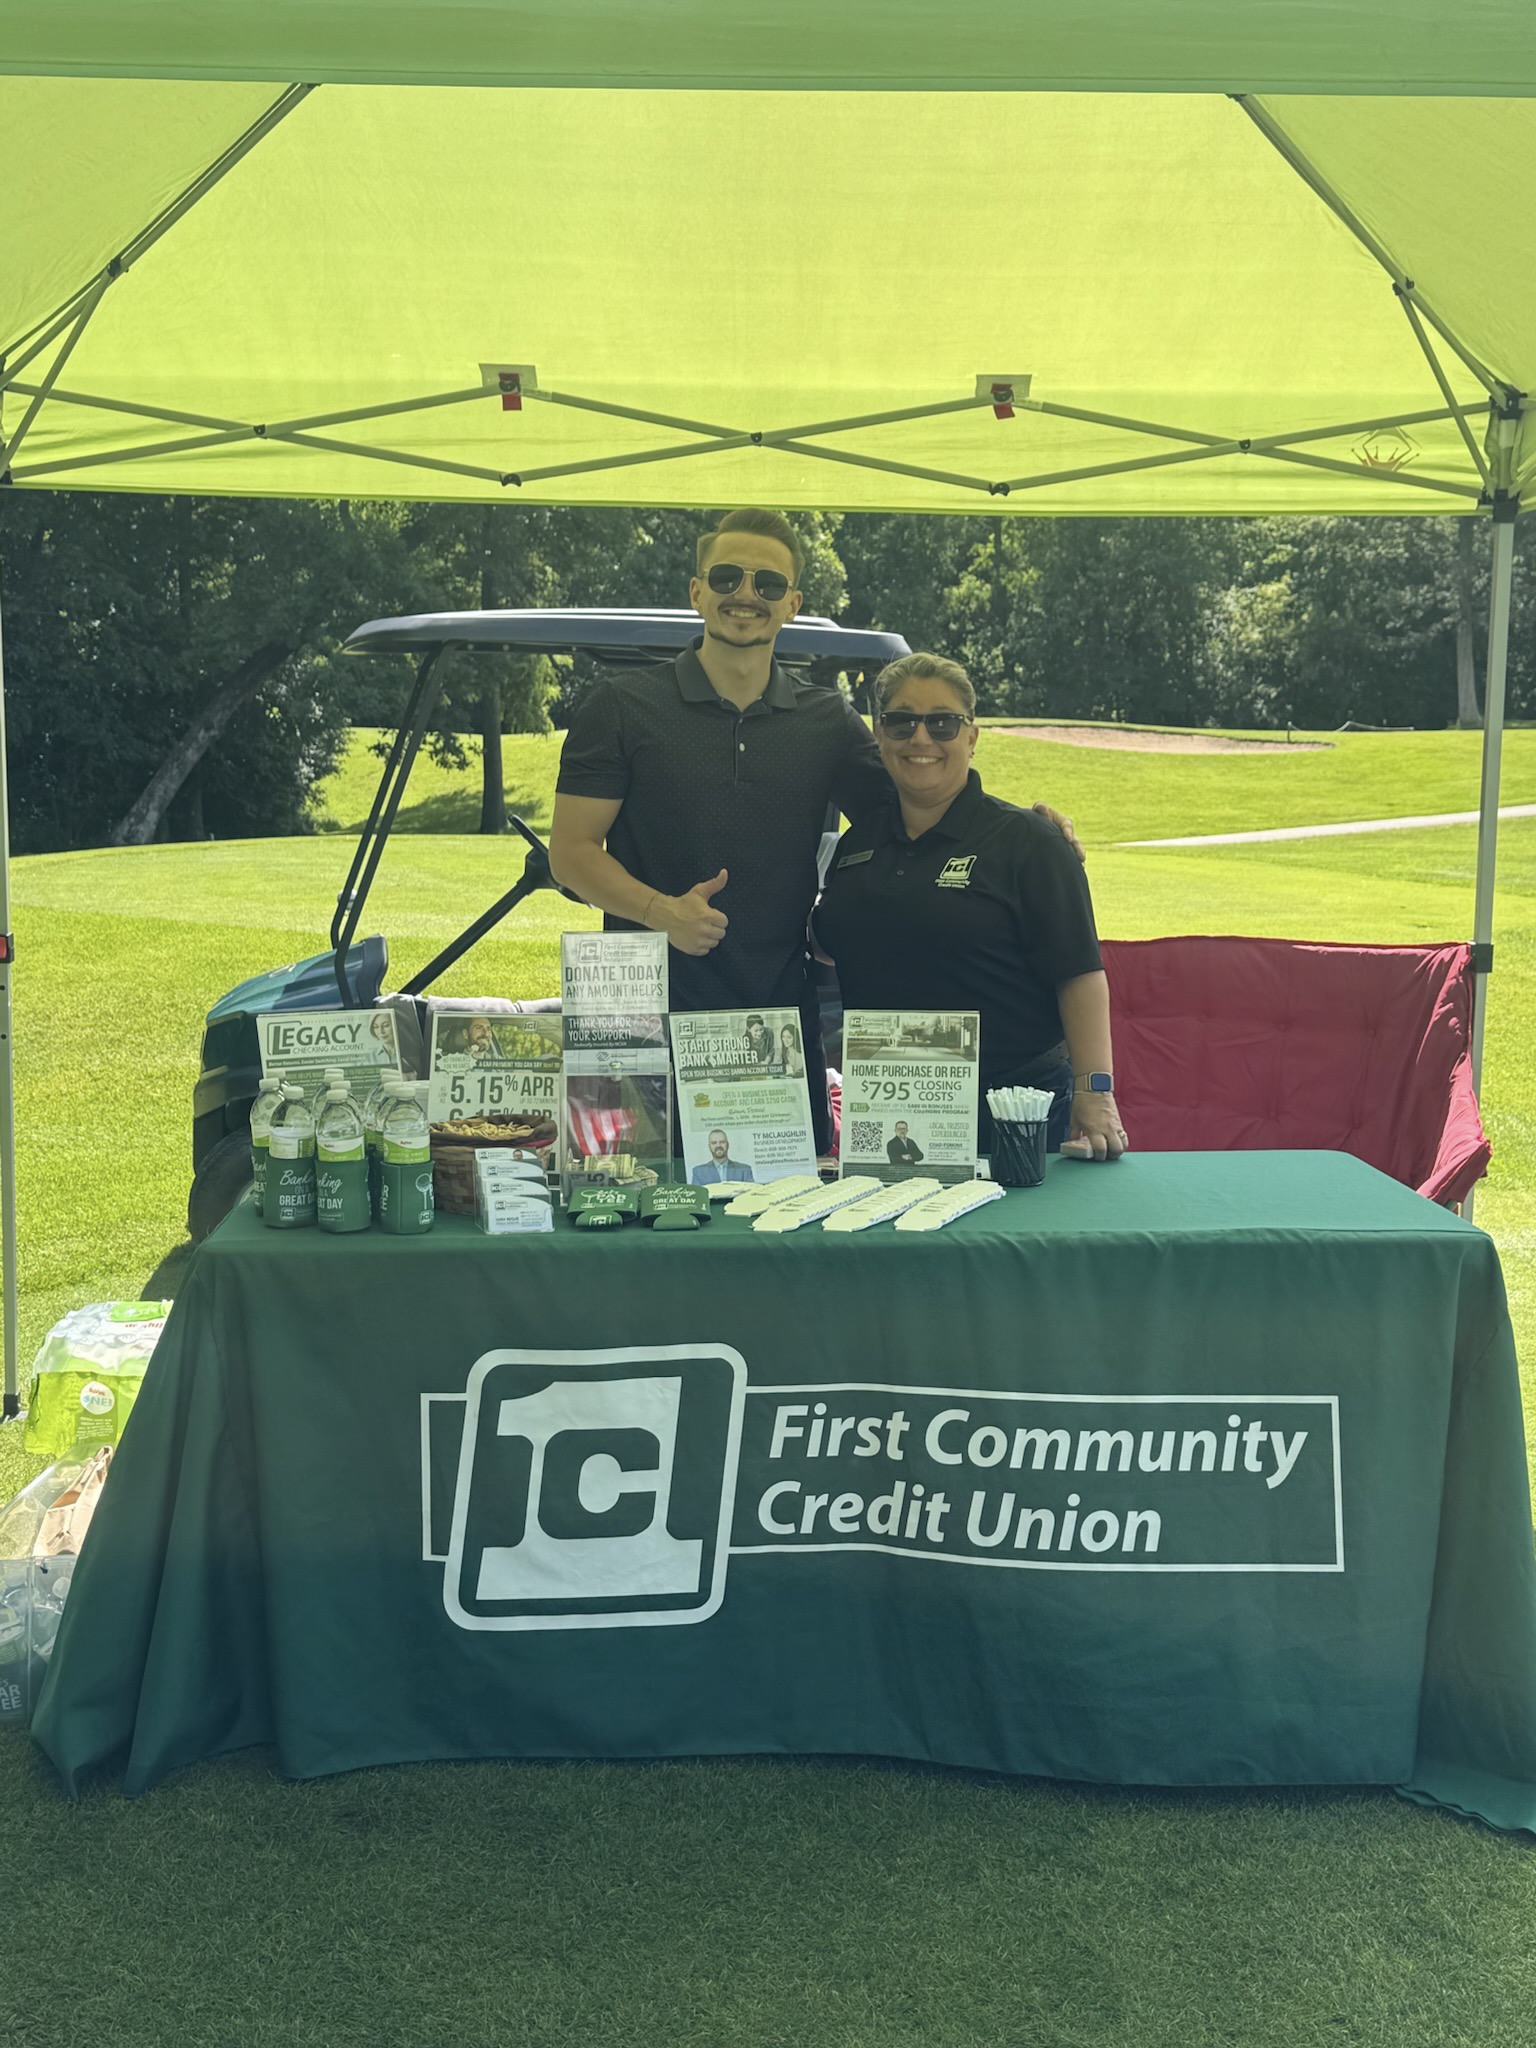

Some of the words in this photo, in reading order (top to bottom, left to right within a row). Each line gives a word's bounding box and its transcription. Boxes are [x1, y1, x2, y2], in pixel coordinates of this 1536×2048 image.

[565, 966, 616, 982] DONATE
[620, 965, 663, 981] TODAY
[566, 985, 585, 998] ANY
[587, 984, 629, 998] AMOUNT
[631, 983, 664, 997] HELPS
[568, 1018, 596, 1029] THANK
[596, 1017, 614, 1028] YOU
[615, 1016, 632, 1028] FOR
[272, 1023, 362, 1055] LEGACY
[568, 1030, 591, 1041] YOUR
[591, 1029, 632, 1041] SUPPORT!
[293, 1045, 330, 1055] CHECKING
[330, 1043, 365, 1053] ACCOUNT
[679, 1039, 710, 1054] START
[711, 1036, 750, 1051] STRONG
[679, 1052, 709, 1068] BANK
[681, 1070, 693, 1078] OPEN
[693, 1069, 706, 1077] YOUR
[706, 1068, 731, 1077] BUSINESS
[746, 1066, 768, 1074] ACCOUNT
[852, 1064, 880, 1077] HOME
[882, 1065, 932, 1077] PURCHASE
[934, 1066, 948, 1077] OR
[950, 1066, 971, 1078] REFI
[861, 1080, 910, 1100] $795
[914, 1081, 962, 1090] CLOSING
[722, 1091, 736, 1099] OPEN
[742, 1089, 768, 1097] BUSINESS
[713, 1099, 738, 1107] ACCOUNT
[739, 1098, 750, 1106] AND
[751, 1097, 766, 1105] EARN
[753, 1132, 761, 1140] TY
[762, 1130, 807, 1139] MCLAUGHLIN
[652, 1187, 696, 1197] Banking
[279, 1195, 306, 1206] GREAT
[326, 1198, 343, 1210] DAY
[769, 1402, 911, 1462] First
[924, 1408, 1308, 1489] Community
[757, 1480, 951, 1543] Credit
[965, 1491, 1162, 1553] Union
[0, 1684, 21, 1698] AR
[0, 1696, 22, 1711] EE
